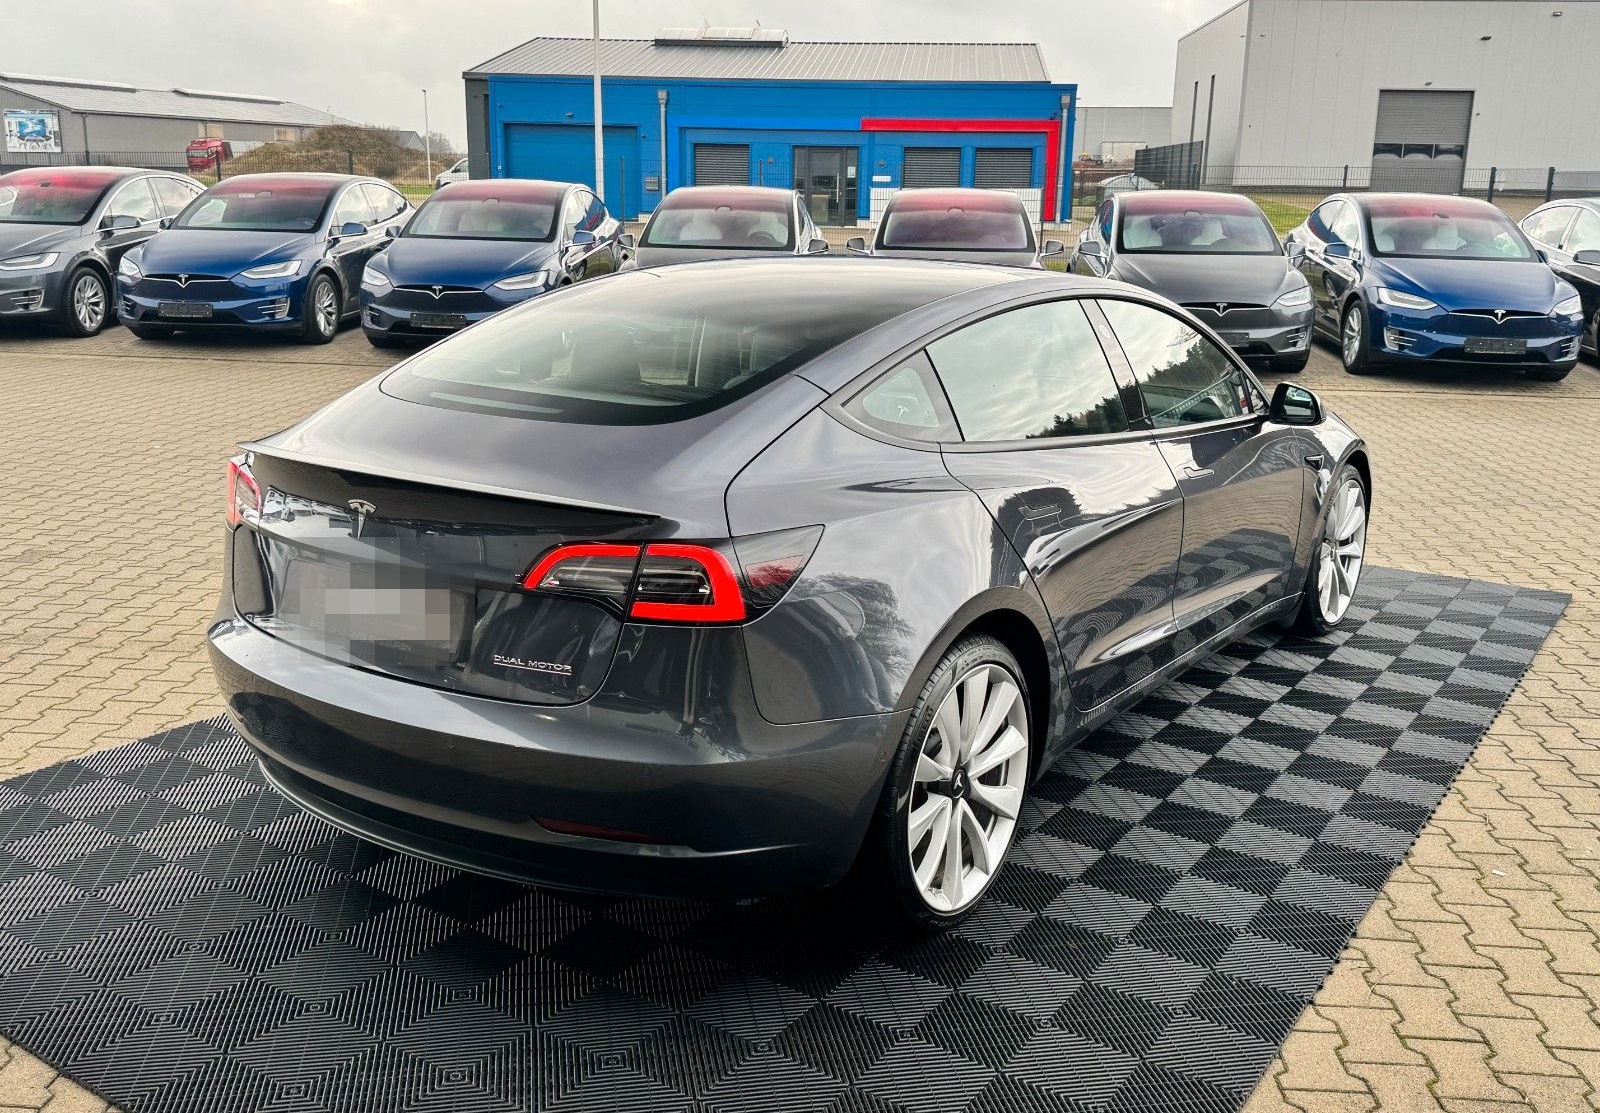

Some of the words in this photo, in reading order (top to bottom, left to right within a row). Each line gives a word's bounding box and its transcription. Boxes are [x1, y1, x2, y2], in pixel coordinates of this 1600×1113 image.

[347, 630, 368, 641] CARS
[493, 654, 525, 665] DUAL
[528, 660, 572, 672] MOTOR
